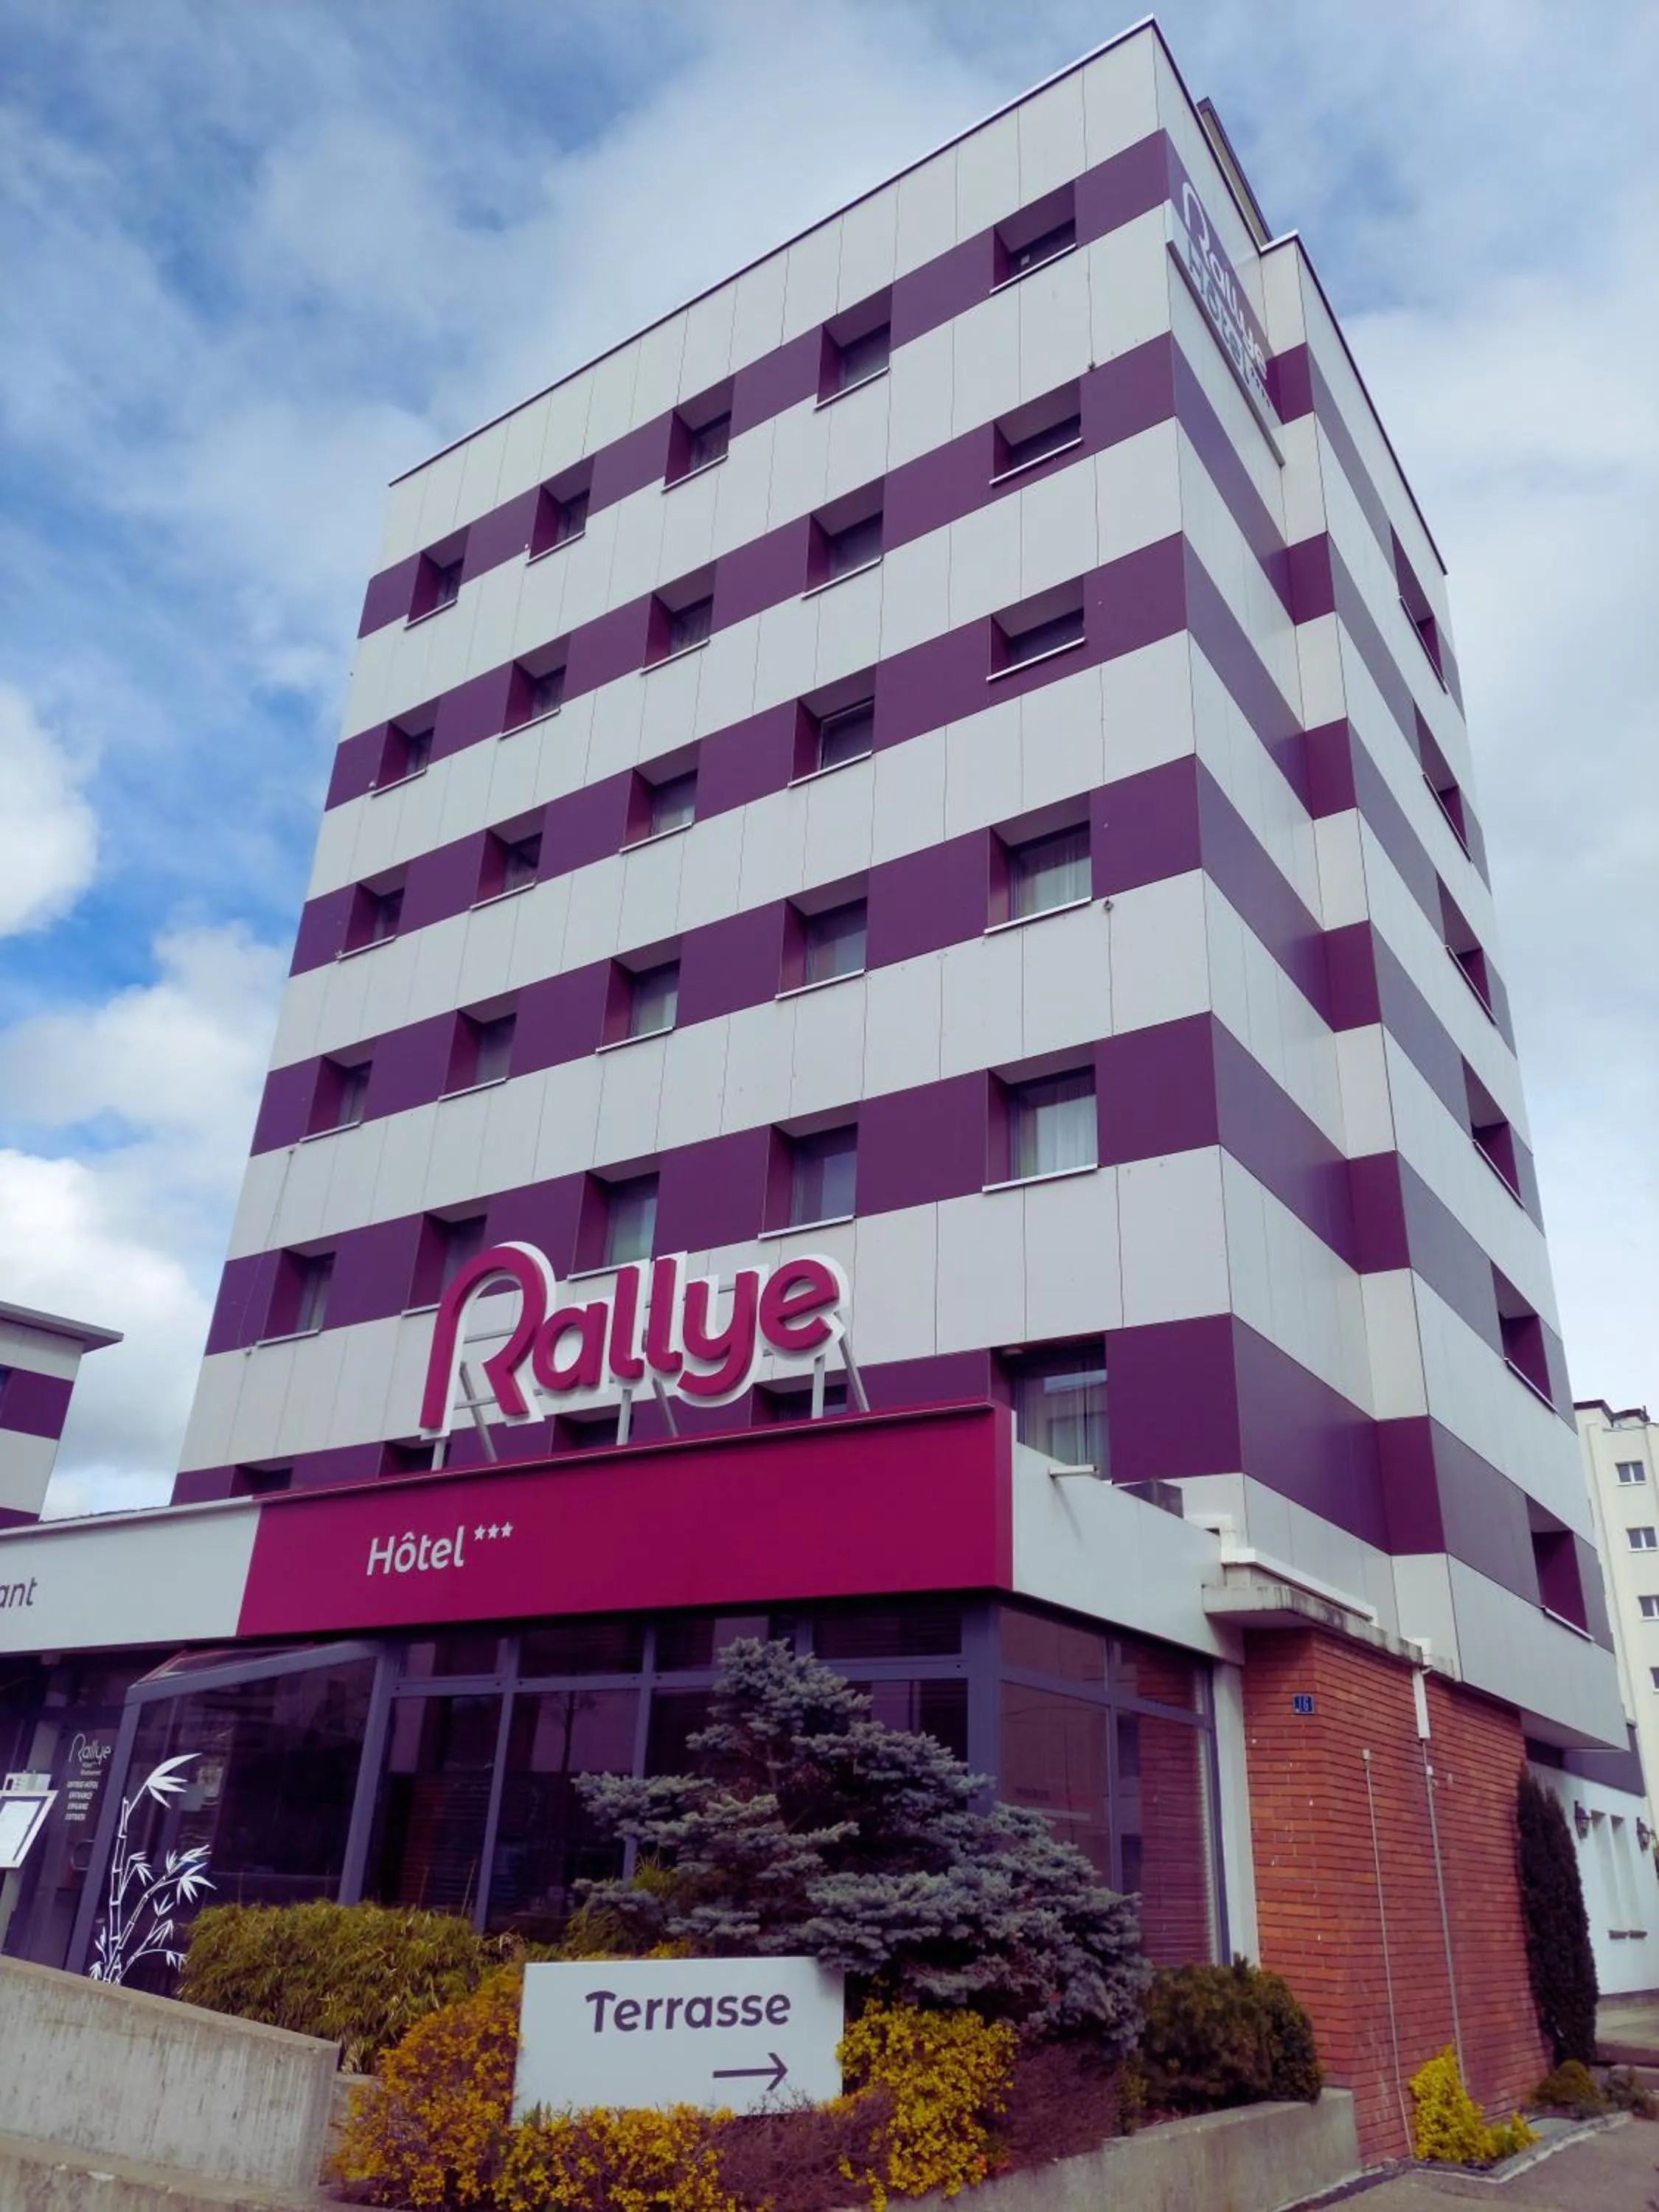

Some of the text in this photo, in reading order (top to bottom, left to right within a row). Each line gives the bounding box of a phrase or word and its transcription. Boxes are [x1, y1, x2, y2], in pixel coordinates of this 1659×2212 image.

[419, 1242, 849, 1432] Rallye
[366, 1524, 465, 1576] Hôtel
[69, 1733, 111, 1764] Rallye
[585, 1990, 791, 2033] Terrasse
